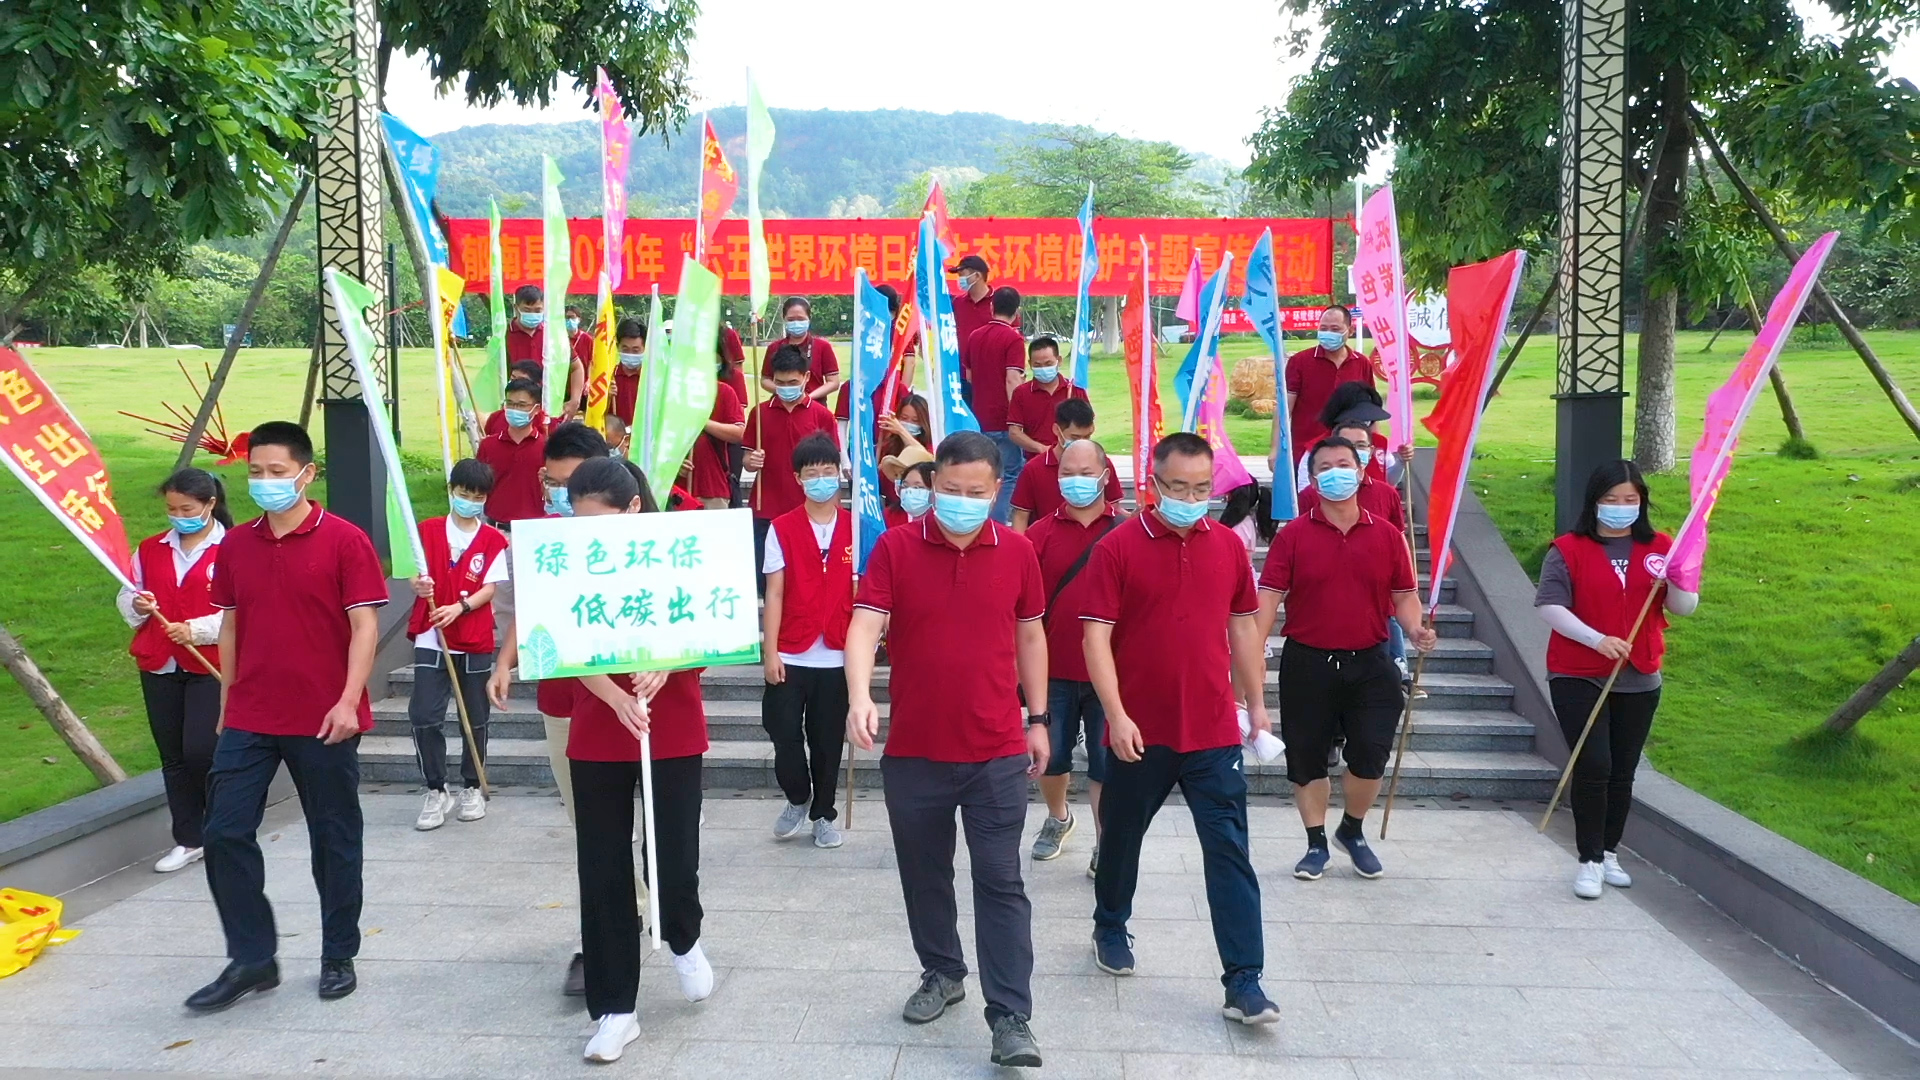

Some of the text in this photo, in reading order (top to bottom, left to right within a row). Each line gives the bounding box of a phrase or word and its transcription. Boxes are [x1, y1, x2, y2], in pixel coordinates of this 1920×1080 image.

[534, 535, 705, 577] 绿色环保
[571, 586, 741, 629] 低碳出行
